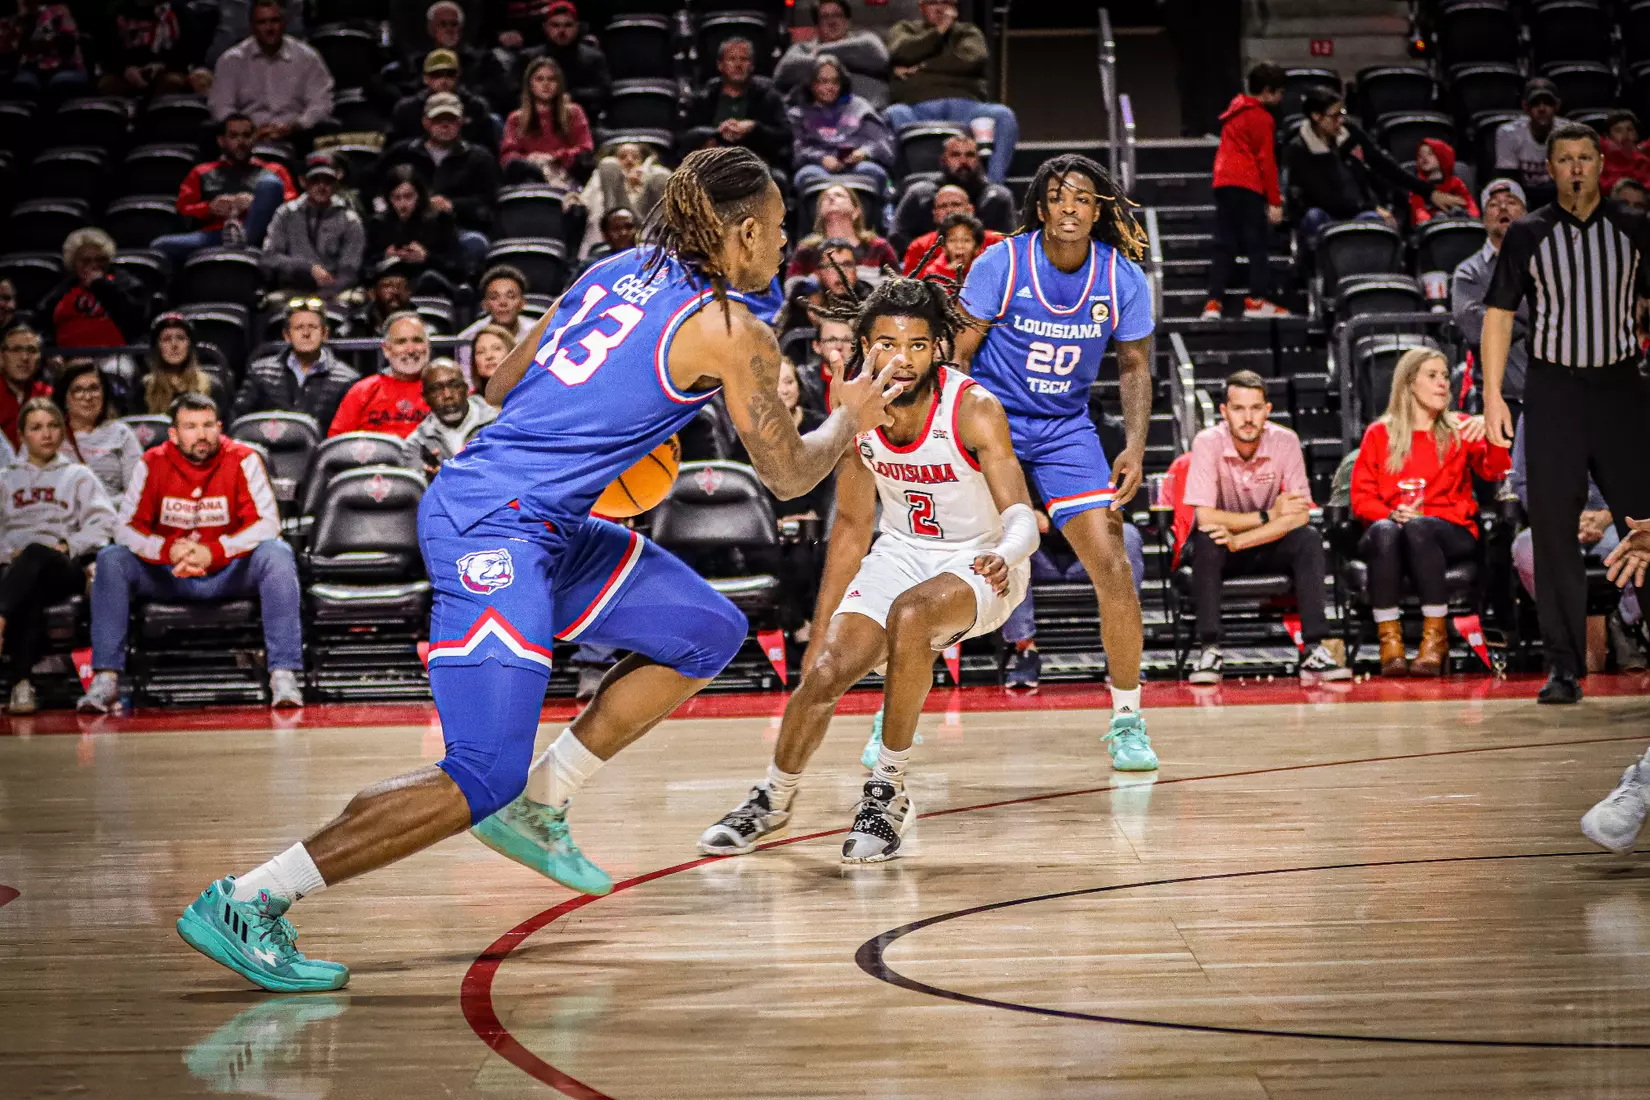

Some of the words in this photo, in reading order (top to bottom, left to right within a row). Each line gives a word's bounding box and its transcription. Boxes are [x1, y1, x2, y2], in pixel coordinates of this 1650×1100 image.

[534, 282, 646, 387] 13
[1013, 314, 1103, 340] LOUISIANA
[1025, 341, 1082, 376] 20
[1026, 376, 1072, 394] TECH
[868, 459, 960, 485] LOUISIANA
[165, 500, 224, 513] LOANA
[903, 489, 945, 539] 2
